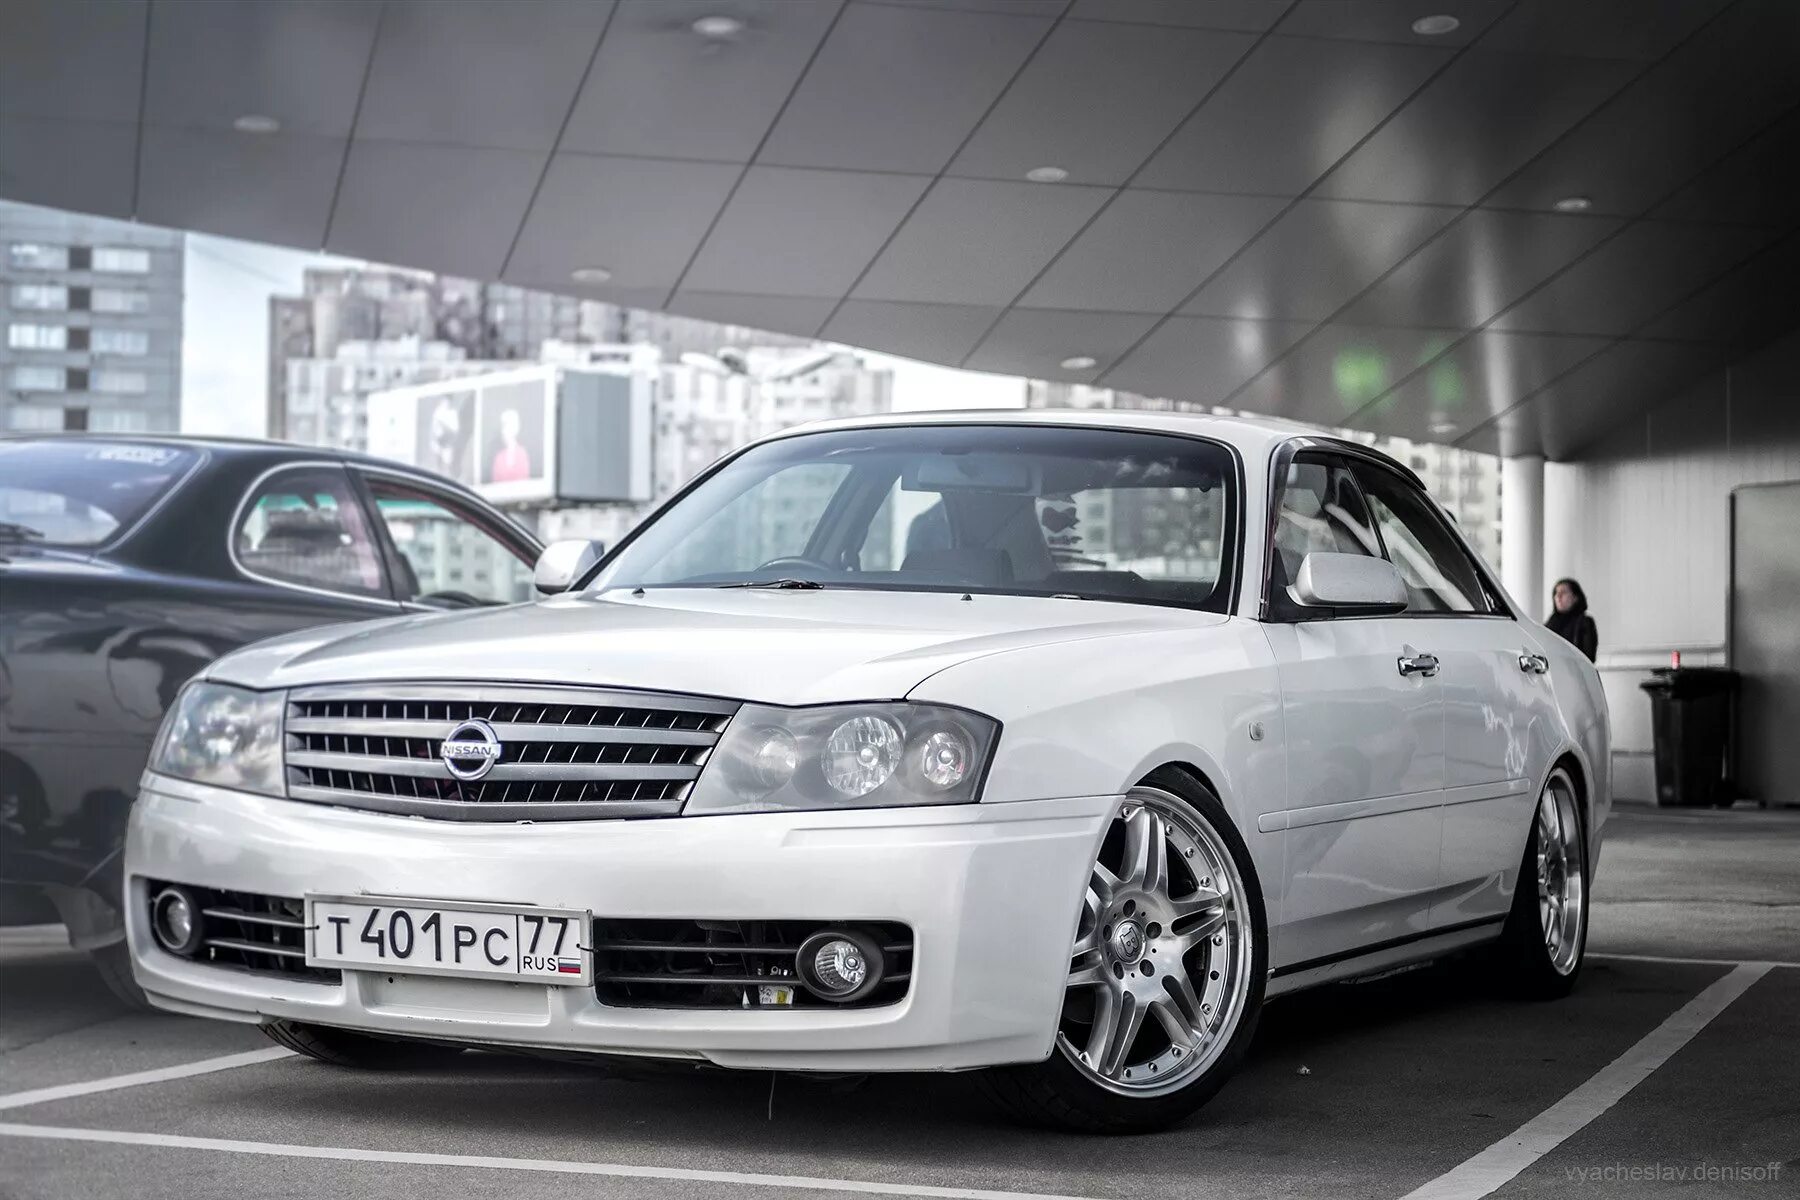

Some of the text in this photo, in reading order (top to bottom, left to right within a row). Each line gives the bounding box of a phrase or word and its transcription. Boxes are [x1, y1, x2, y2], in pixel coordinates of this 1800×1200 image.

[442, 744, 492, 756] NISSAN
[523, 915, 568, 956] 77
[522, 955, 557, 971] RUS
